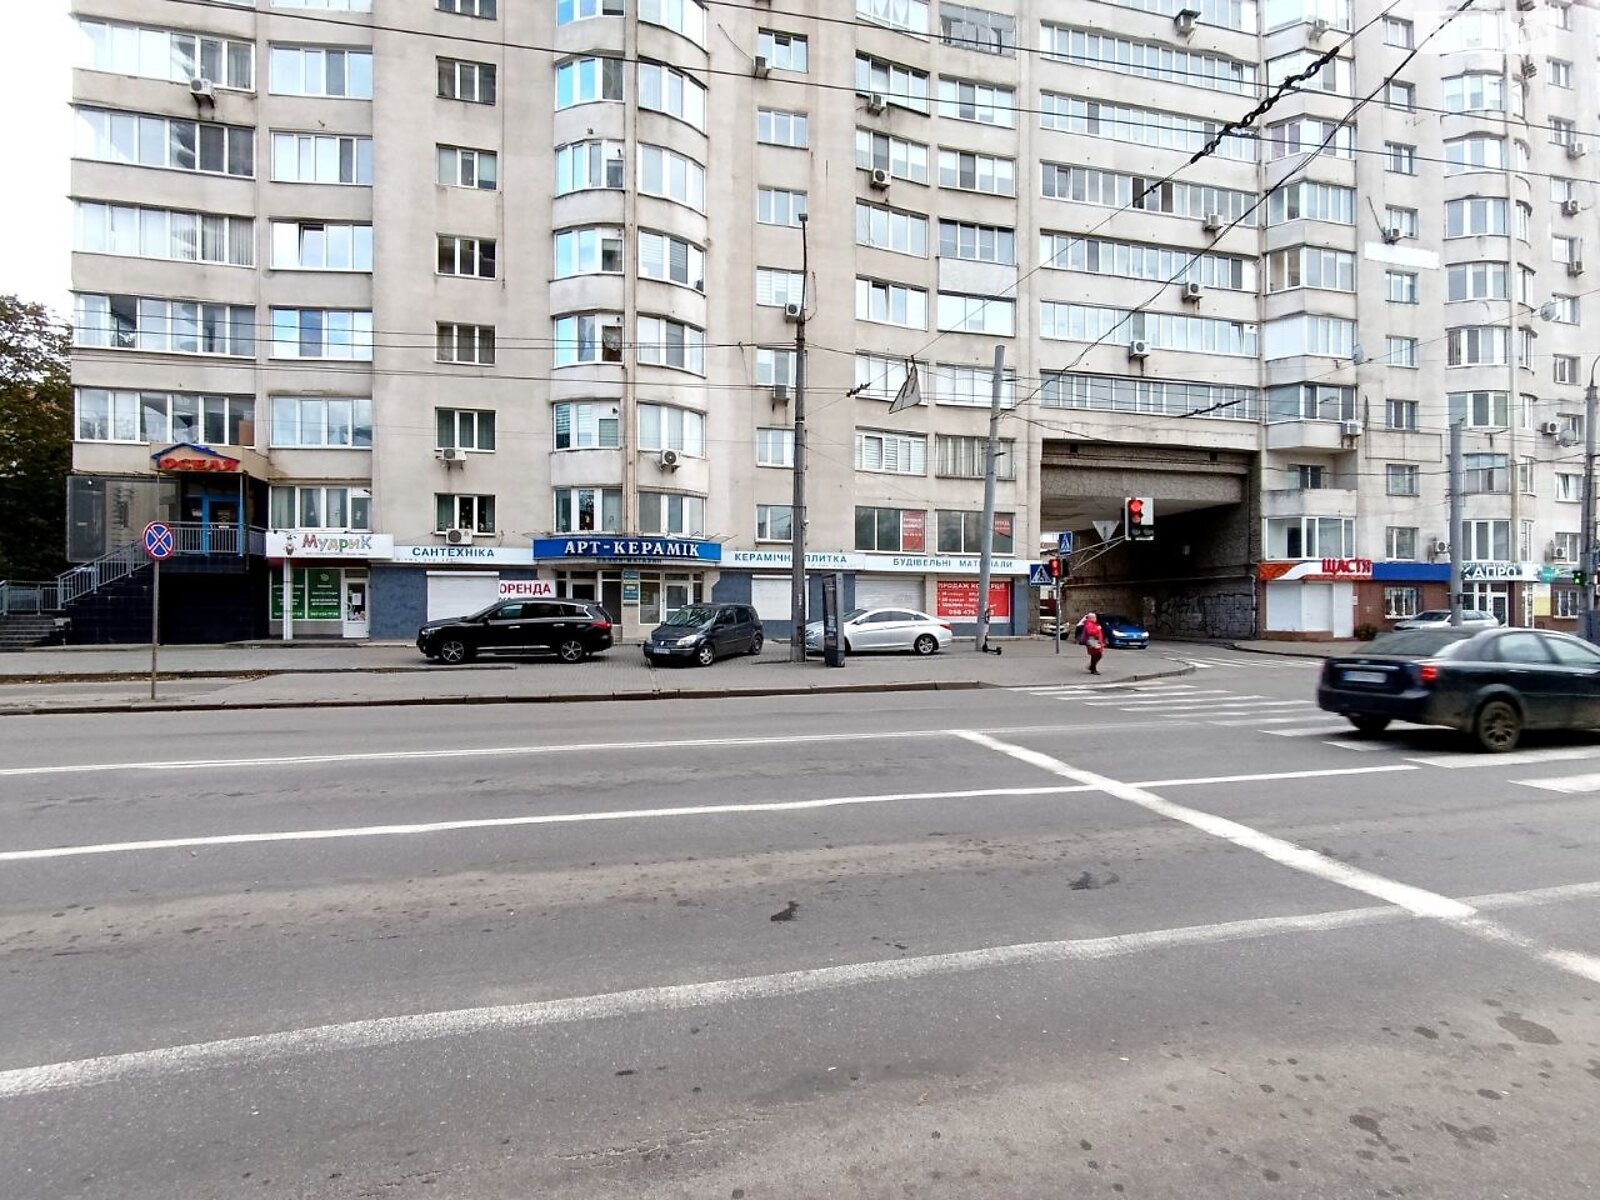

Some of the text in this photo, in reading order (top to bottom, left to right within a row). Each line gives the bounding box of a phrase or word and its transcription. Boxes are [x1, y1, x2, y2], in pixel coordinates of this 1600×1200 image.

[412, 547, 495, 557] САНТЕХНІКА
[734, 552, 793, 562] КЕРАМІЧН
[893, 557, 1013, 568] БУДІВЕЛЬНІ МАТІАЛИ
[1322, 558, 1372, 575] ЩАСТЯ
[499, 583, 551, 596] ОРЕНДА
